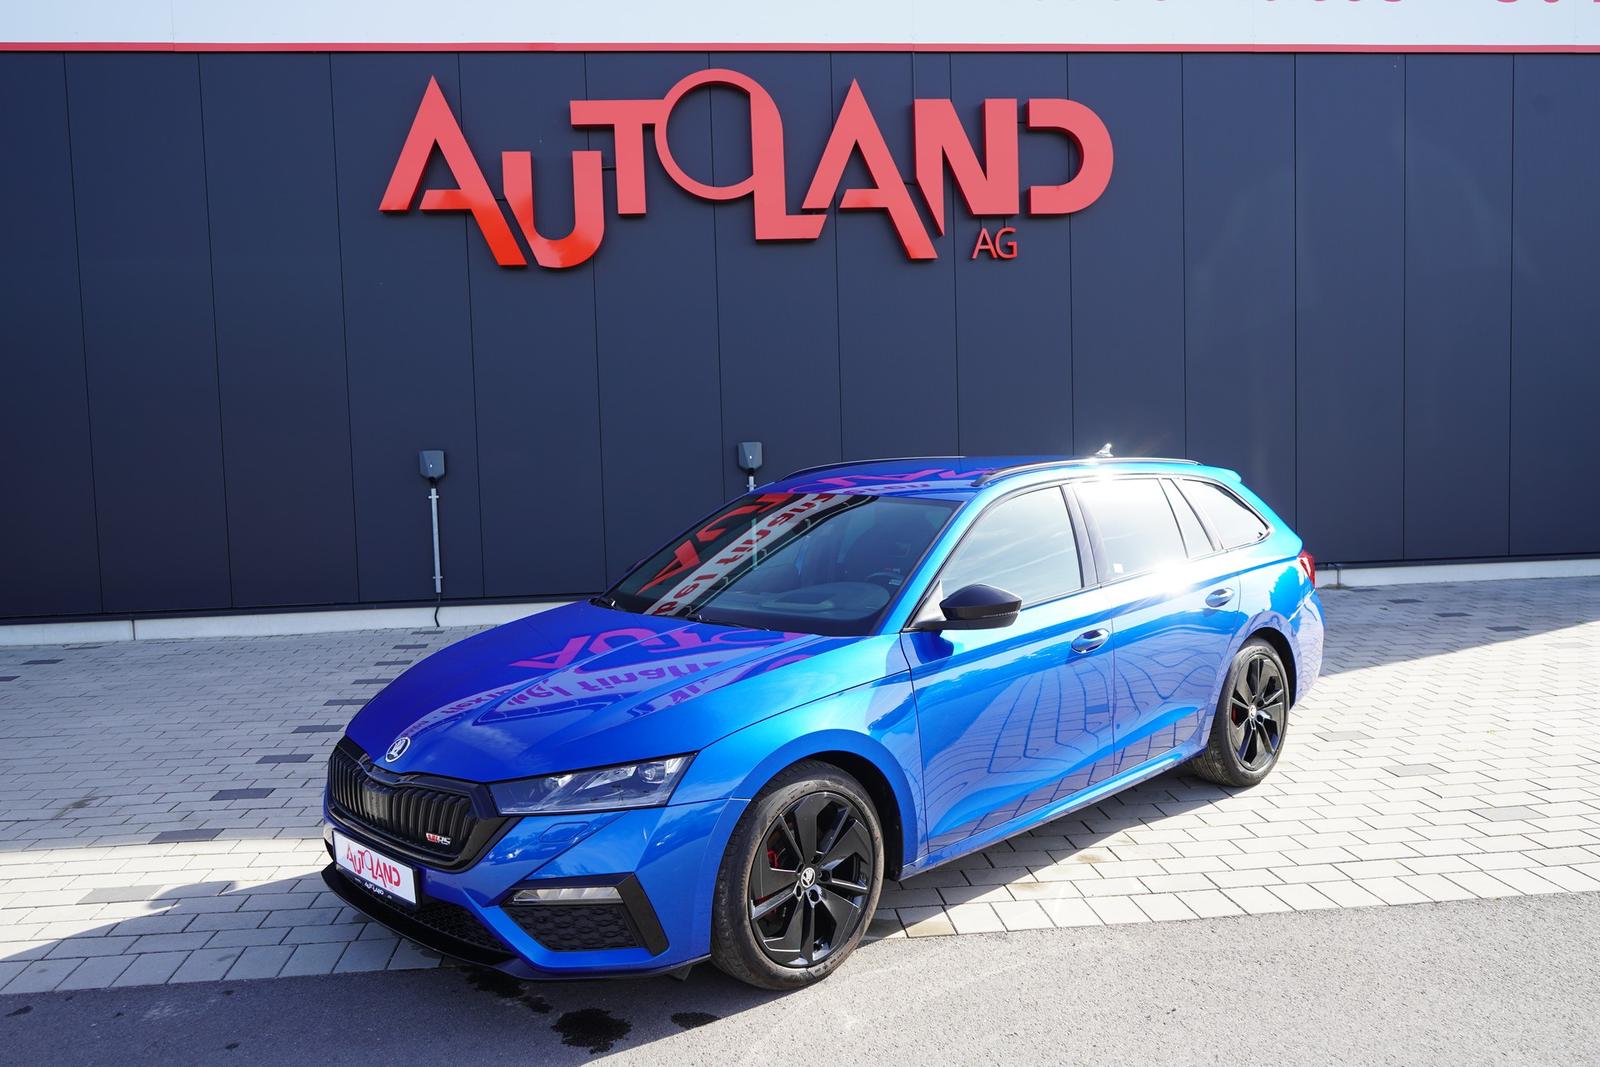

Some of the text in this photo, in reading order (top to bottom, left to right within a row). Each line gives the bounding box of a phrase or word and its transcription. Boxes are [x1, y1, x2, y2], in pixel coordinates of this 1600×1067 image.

[379, 67, 1114, 269] AUTOLAND
[971, 226, 1019, 260] AG
[346, 843, 401, 888] AUTOLAND
